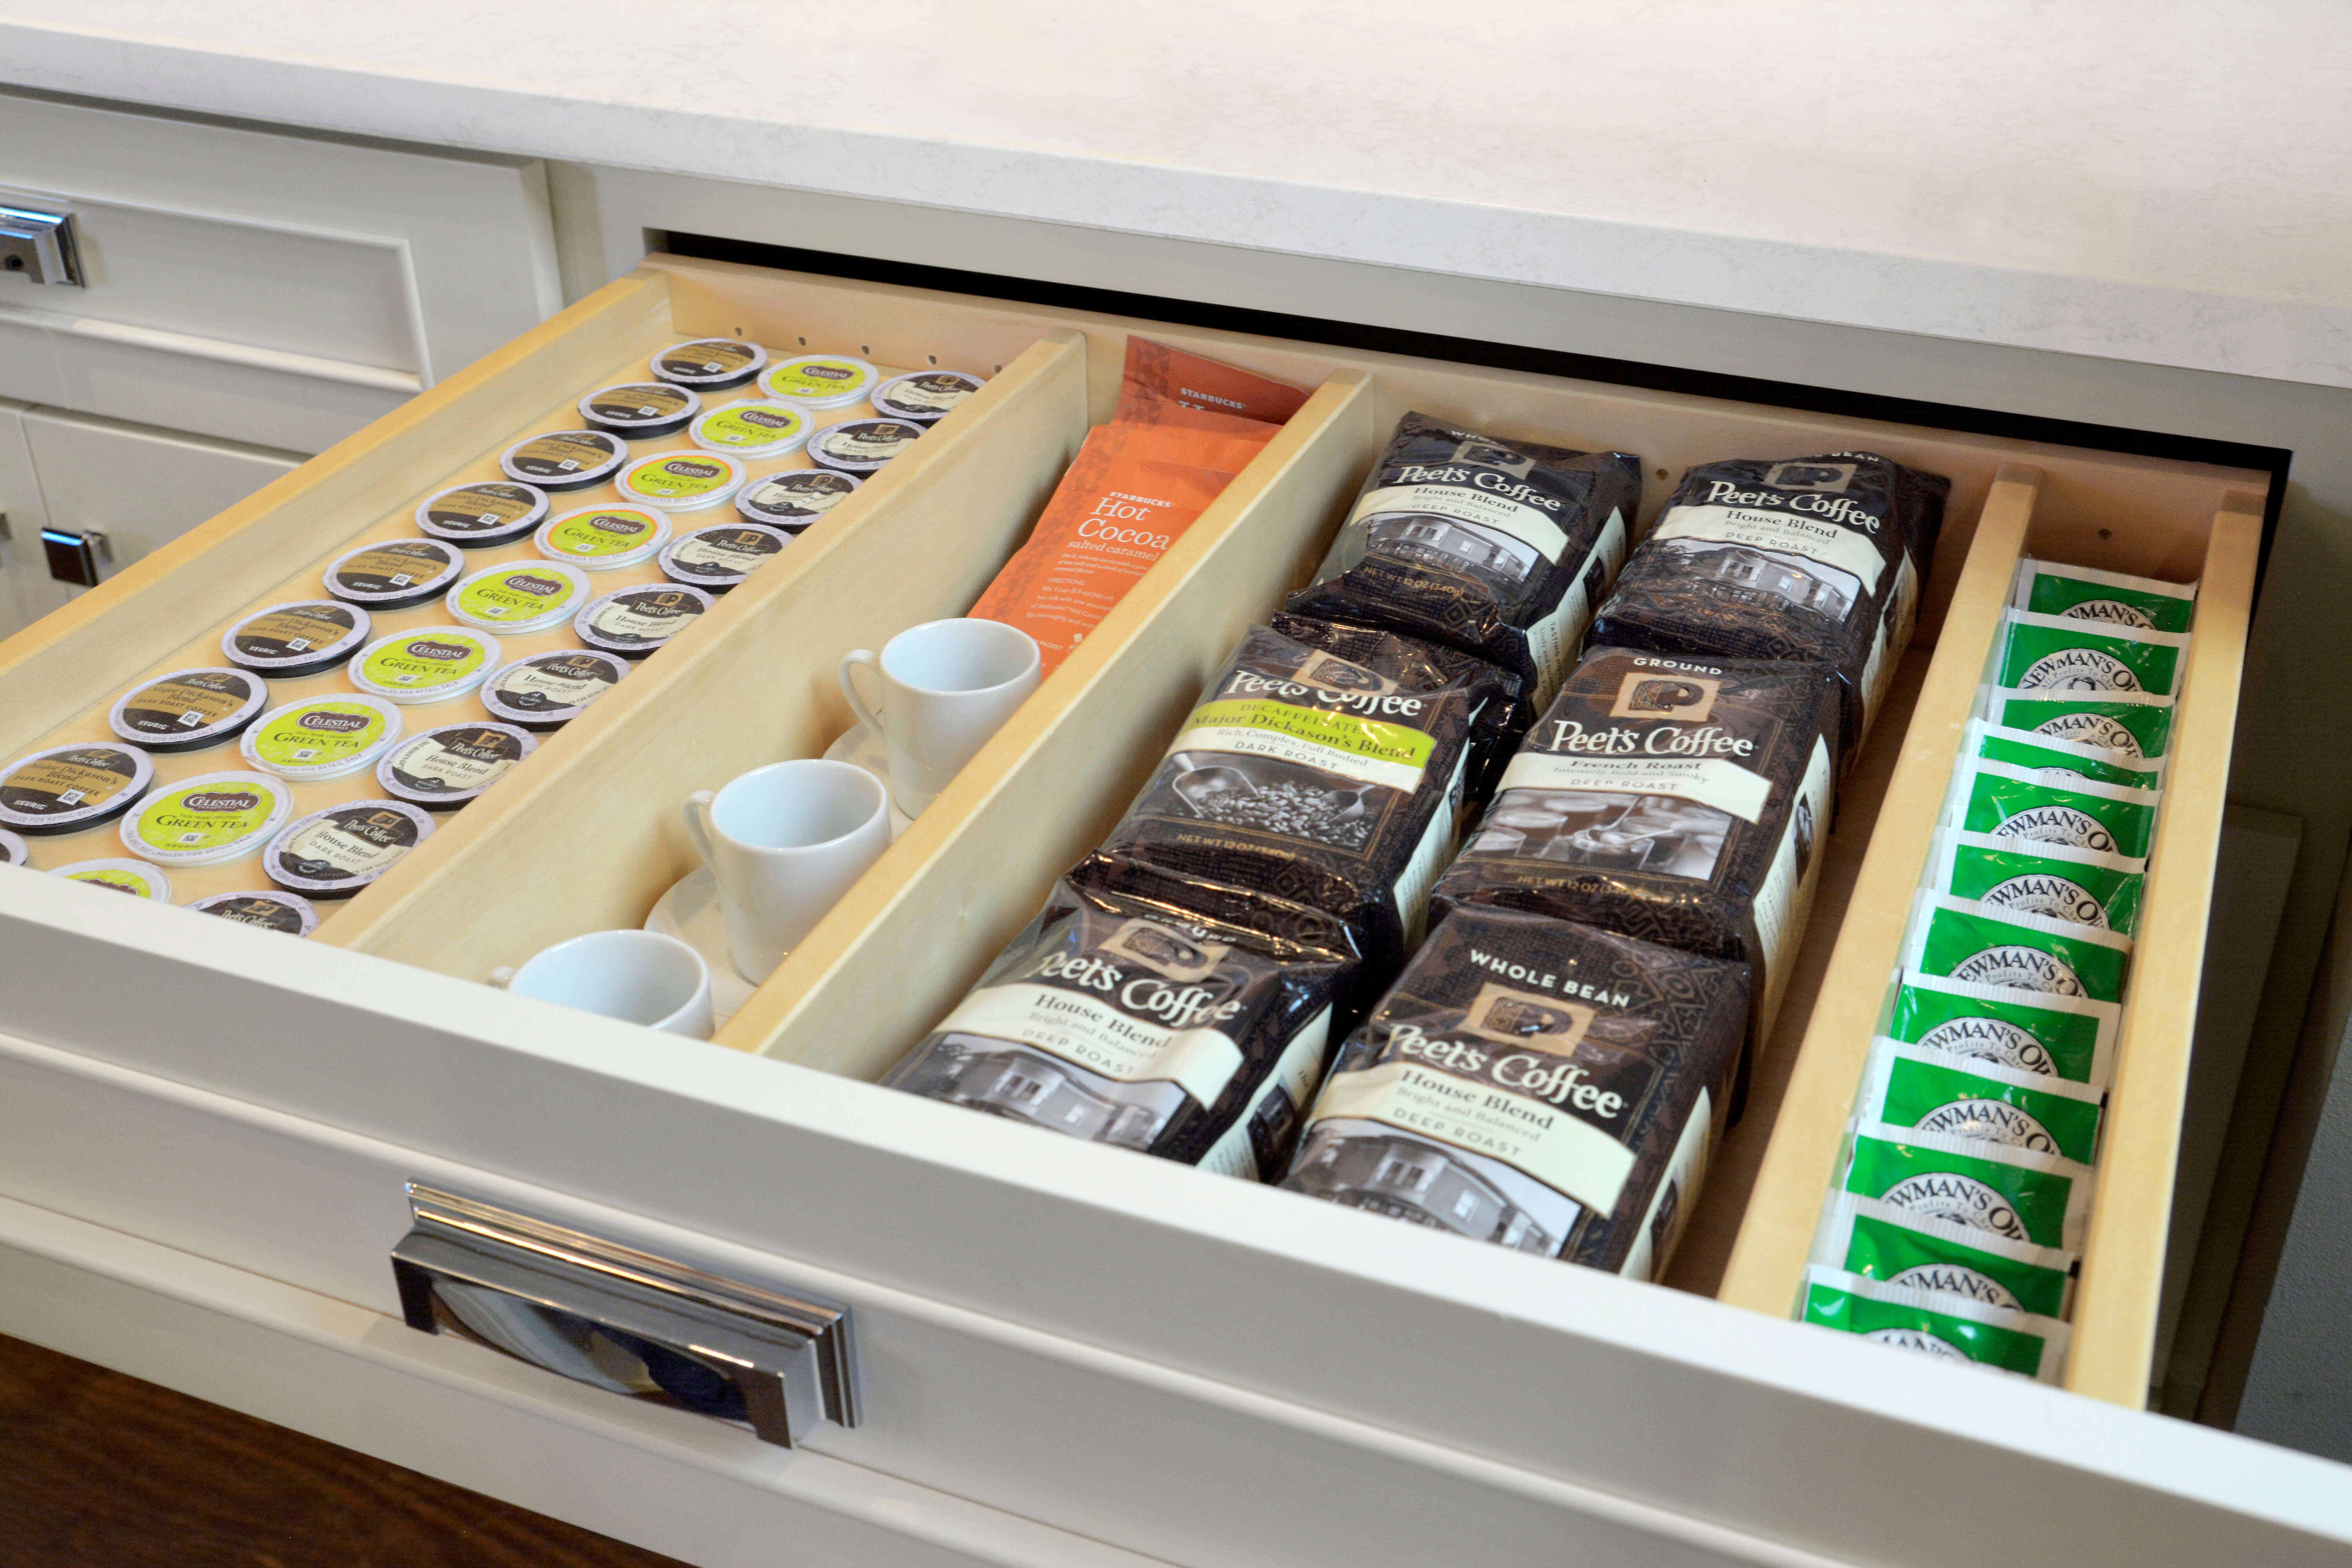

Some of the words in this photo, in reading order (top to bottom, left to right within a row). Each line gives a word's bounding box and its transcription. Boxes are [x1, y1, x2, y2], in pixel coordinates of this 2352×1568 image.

[1181, 388, 1243, 410] STARBUCKS
[668, 463, 714, 476] CELESTIAL
[641, 474, 686, 488] GREEN
[1394, 466, 1470, 484] Peet's
[1474, 472, 1562, 511] Coffee
[1090, 497, 1151, 520] Hot
[1109, 492, 1172, 507] STARBUCKS
[1412, 487, 1466, 498] House
[1470, 492, 1519, 513] Blend
[1707, 481, 1785, 506] Peet's
[1788, 494, 1880, 535] Coffee
[1412, 503, 1446, 513] DEEP
[1454, 508, 1500, 524] ROAST
[593, 518, 639, 533] CELESTIAL
[1078, 518, 1170, 549] Cocoa
[1726, 510, 1782, 524] House
[1786, 518, 1838, 539] Blend
[564, 528, 608, 543] GREEN
[1726, 532, 1763, 542] DEEP
[1769, 539, 1819, 555] ROAST
[1067, 540, 1106, 551] salted
[1106, 547, 1160, 561] caramel
[1364, 566, 1385, 576] NET
[510, 577, 556, 594] CELESTIAL
[477, 589, 518, 606] GREEN
[523, 601, 544, 610] TEA
[412, 644, 464, 658] CELESTIAL
[380, 658, 430, 673] GREEN
[1633, 657, 1723, 675] GROUND
[2024, 652, 2116, 689] NEWMAN'S
[160, 700, 186, 708] ROAST
[181, 689, 234, 707] Dickason's
[138, 720, 169, 730] KEURIG
[304, 716, 362, 728] CELESTIAL
[274, 732, 330, 746] GREEN
[1195, 714, 1247, 725] Major
[1251, 714, 1352, 748] Dickason's
[1357, 739, 1416, 759] Blend
[1547, 720, 1640, 754] Peet's
[1645, 726, 1754, 757] Coffee
[472, 747, 501, 759] Coffee
[1235, 741, 1277, 753] DARK
[1284, 750, 1339, 769] ROAST
[60, 766, 118, 785] Dickason's
[422, 764, 443, 773] DARK
[445, 770, 473, 780] ROAST
[426, 755, 457, 768] House
[458, 762, 489, 775] Blend
[1569, 760, 1639, 770] French
[1649, 761, 1703, 770] Roast
[38, 778, 65, 786] ROAST
[47, 771, 78, 782] Blend
[1621, 780, 1679, 790] ROAST
[14, 799, 48, 810] KEURIG
[189, 797, 250, 807] CELESTIAL
[156, 815, 215, 828] GREEN
[1996, 811, 2092, 837] EWMAN'S
[364, 826, 395, 843] Coffee
[309, 840, 332, 855] DARK
[334, 853, 361, 864] ROAST
[315, 831, 348, 849] House
[347, 846, 380, 860] Blend
[1957, 950, 2058, 982] EWMAN'S
[1470, 949, 1557, 988] WHOLE
[1563, 979, 1630, 1008] BEAN
[1122, 978, 1242, 1026] Coffee
[1034, 994, 1104, 1023] House
[1107, 1017, 1172, 1049] Blend
[1022, 1028, 1069, 1047] DEEP
[1076, 1046, 1136, 1074] ROAST
[1381, 1023, 1488, 1072] Peet's
[1491, 1054, 1624, 1118] Coffee
[1401, 1068, 1477, 1103] House
[1484, 1094, 1555, 1130] Blend
[1922, 1104, 2030, 1136] EWMAN'S
[1393, 1107, 1448, 1130] DEEP
[1454, 1127, 1522, 1157] ROAST
[1886, 1179, 1992, 1210] WMAN'S
